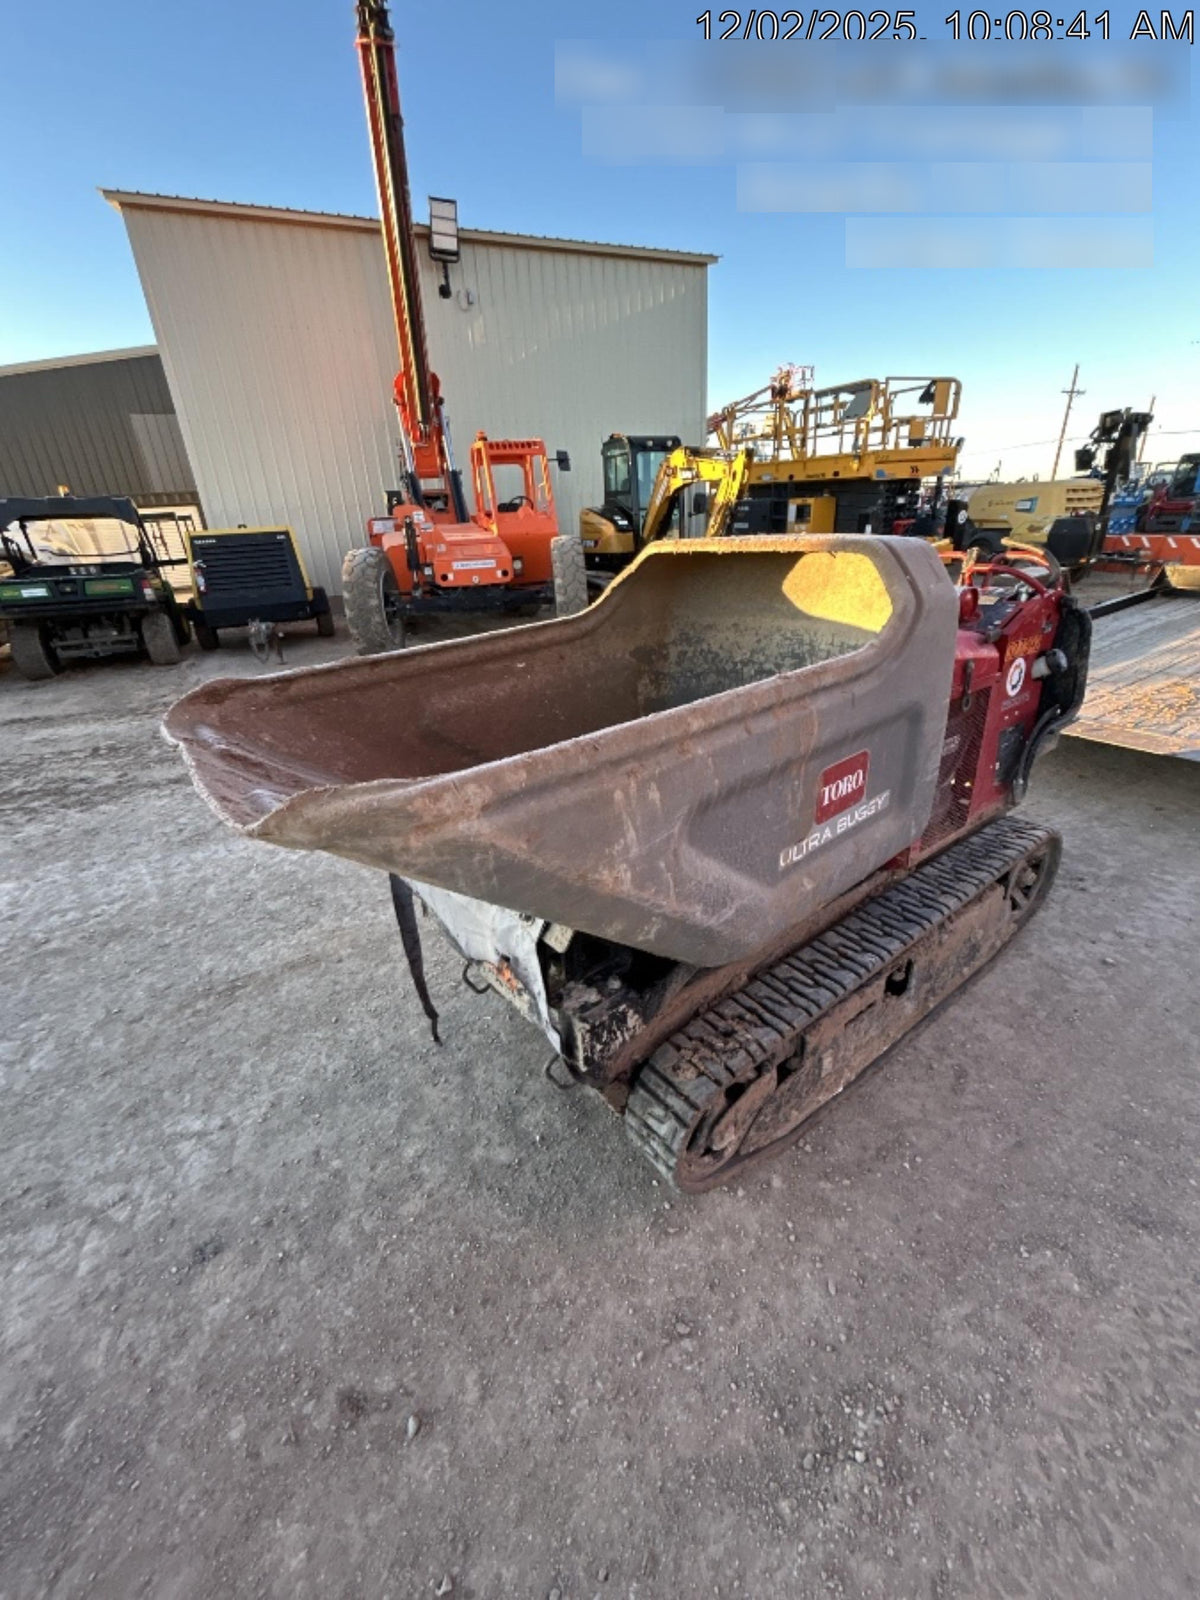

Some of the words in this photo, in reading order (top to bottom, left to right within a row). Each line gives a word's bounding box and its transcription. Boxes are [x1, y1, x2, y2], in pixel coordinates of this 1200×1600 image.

[822, 770, 864, 805] TORO
[779, 828, 832, 867] ULTRA
[837, 791, 890, 833] BUGGY
